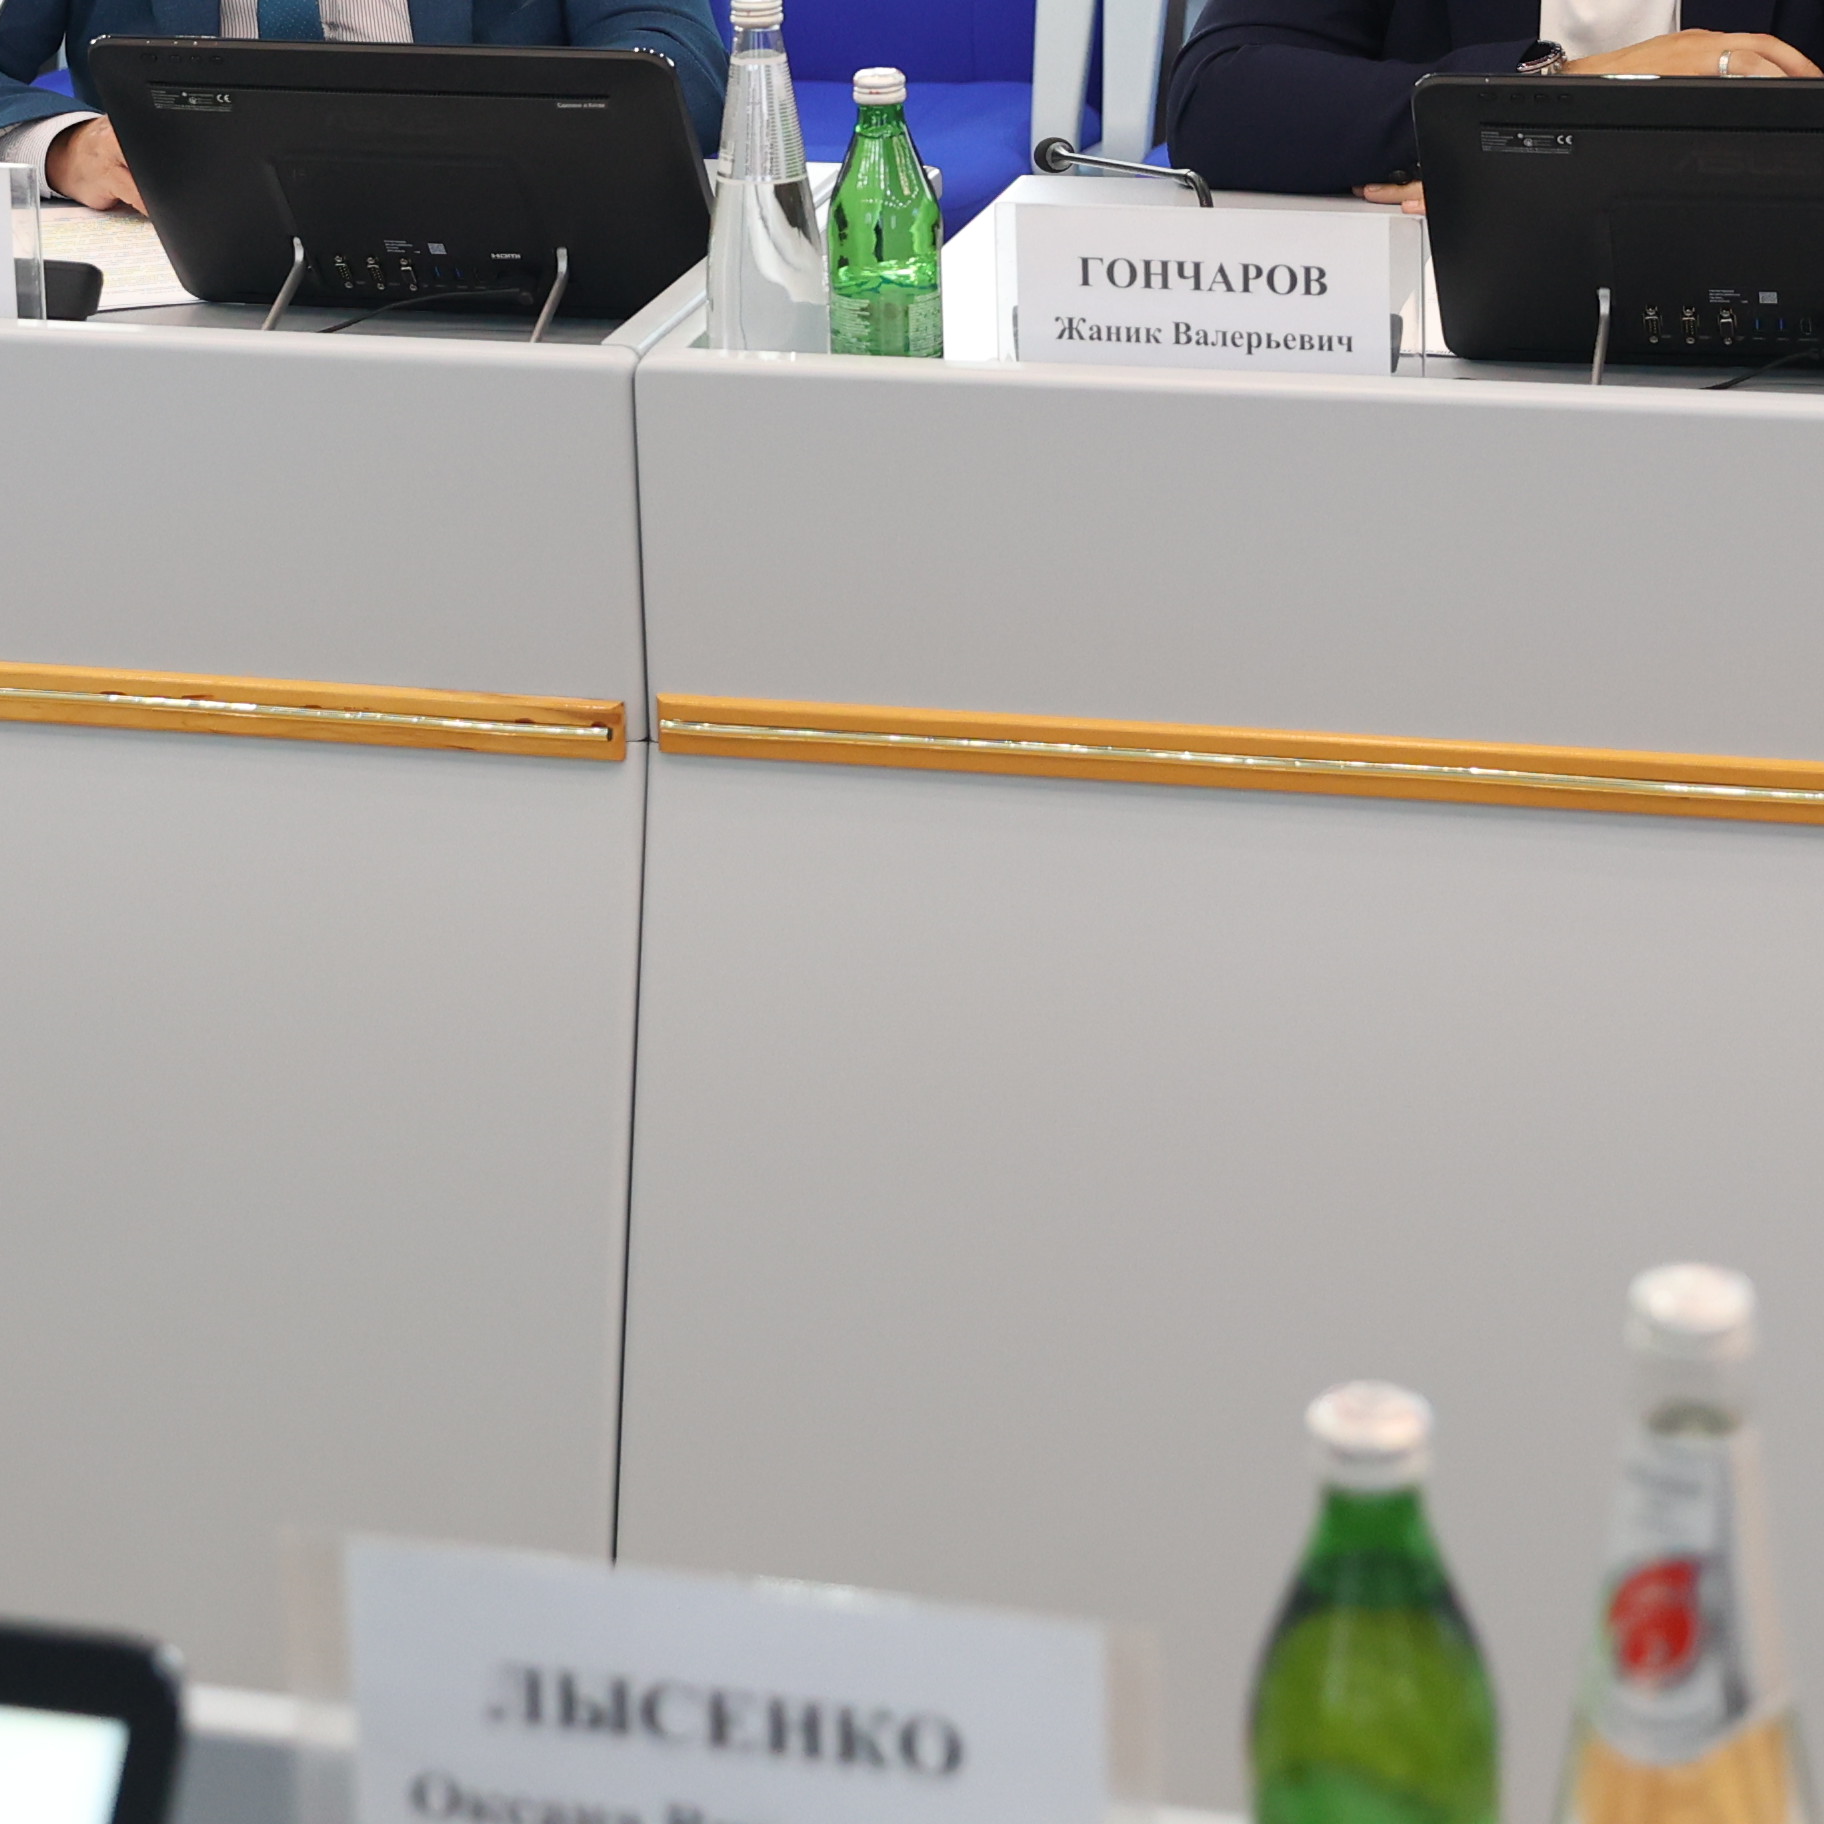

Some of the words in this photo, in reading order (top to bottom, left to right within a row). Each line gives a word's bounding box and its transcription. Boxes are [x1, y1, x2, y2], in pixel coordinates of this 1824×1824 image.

[1078, 256, 1329, 297] ГОНЧАРОВ
[1054, 316, 1162, 345] Жаник
[1172, 321, 1354, 355] Валерьевич
[484, 1660, 965, 1778] ЛЫСЕНКО
